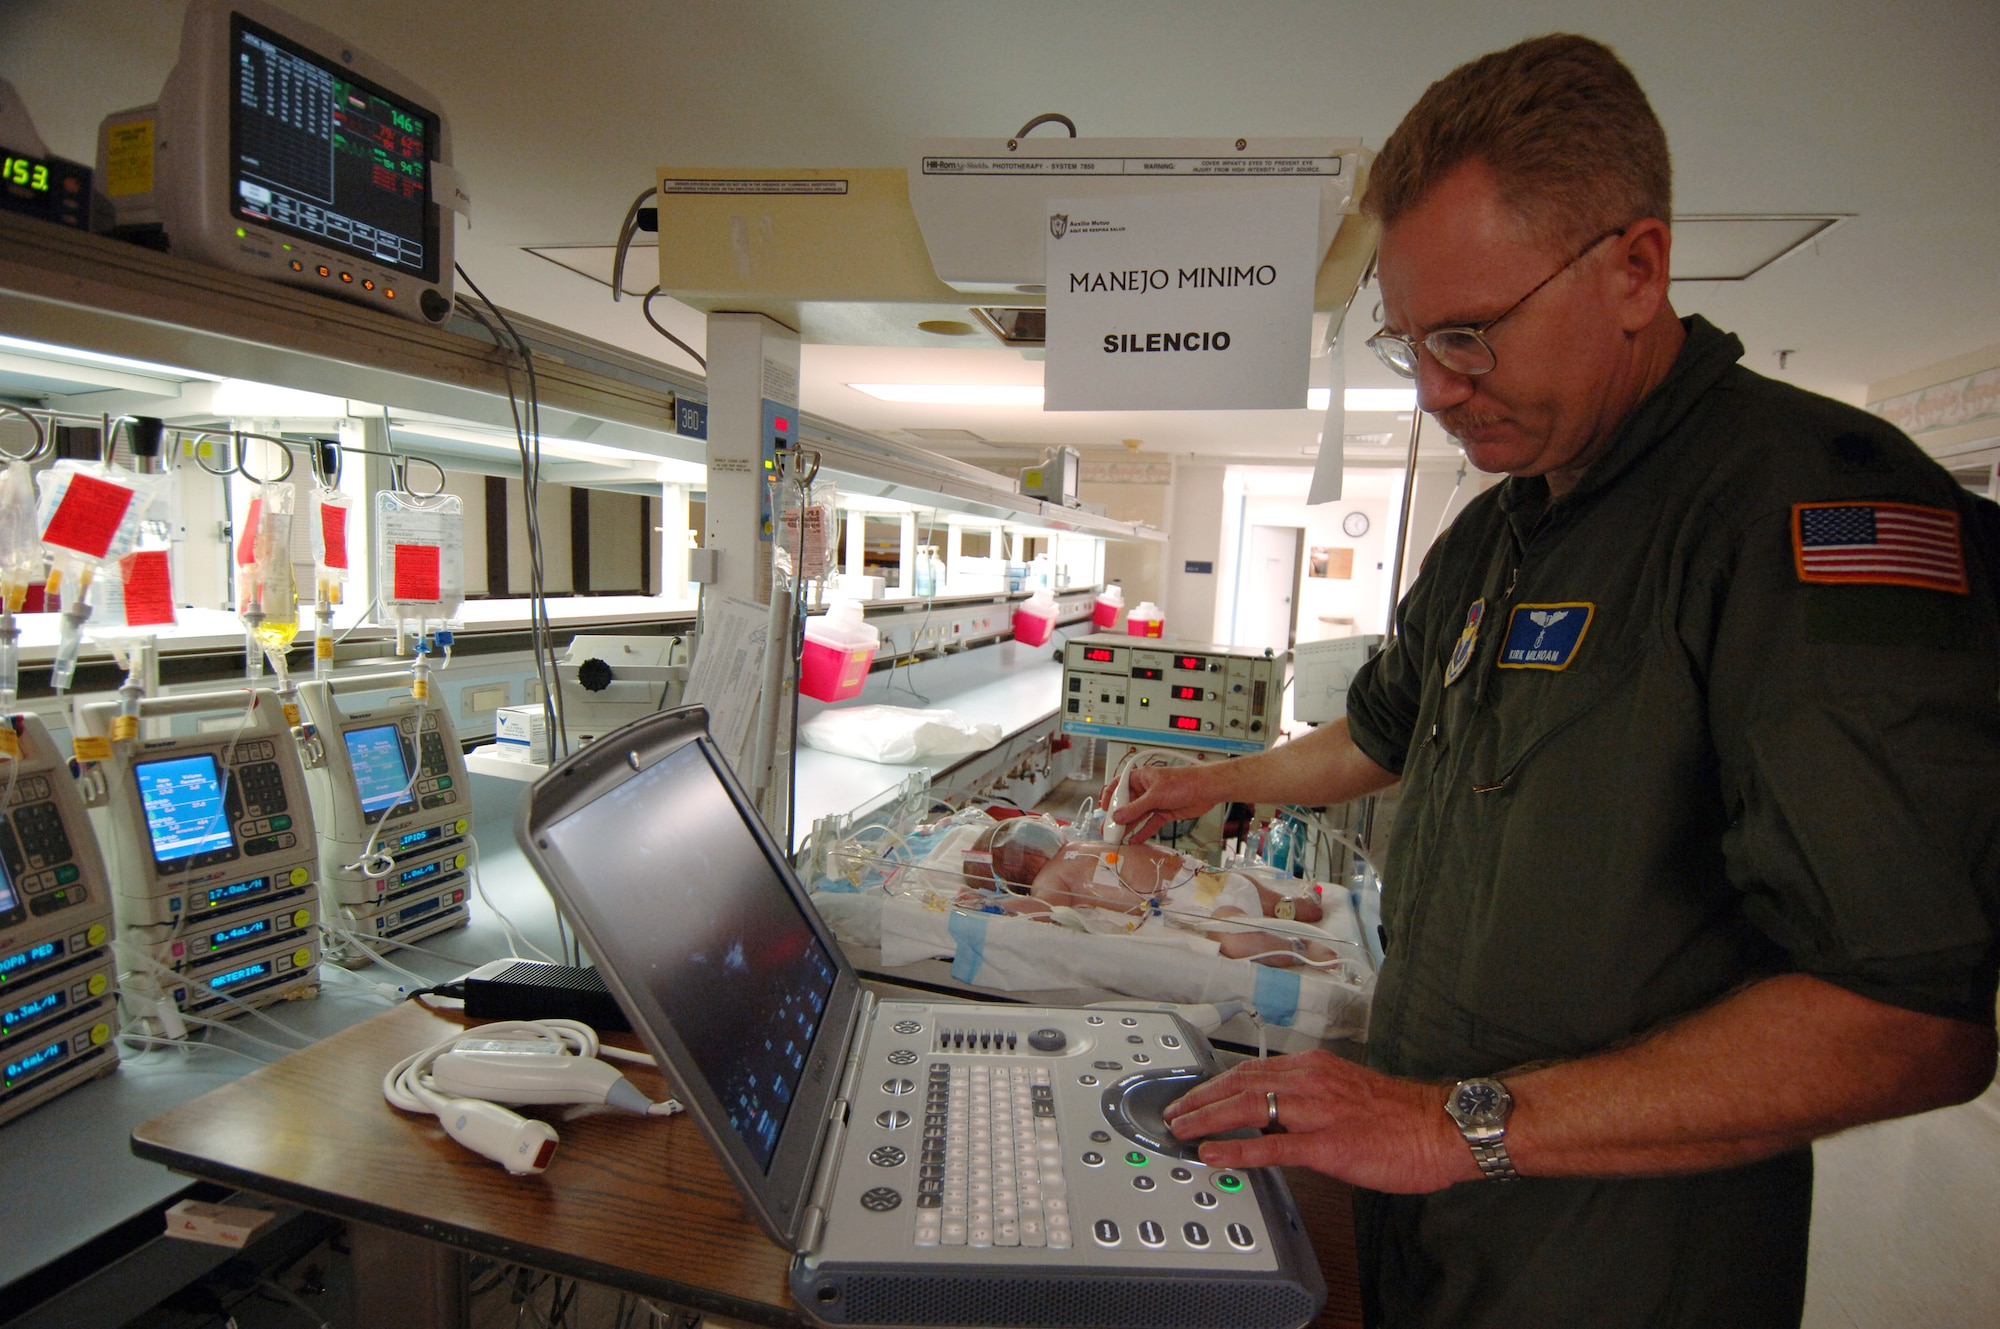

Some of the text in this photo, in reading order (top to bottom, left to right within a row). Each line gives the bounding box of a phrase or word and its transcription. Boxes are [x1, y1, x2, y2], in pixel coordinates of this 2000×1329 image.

[392, 110, 413, 132] 146
[1070, 264, 1277, 295] MANEJO MINIMO
[1102, 330, 1231, 354] SILENCIO
[1509, 650, 1559, 662] KIRK MILHOAN
[209, 879, 262, 900] 17.0mL/H
[215, 921, 264, 941] 0.4mL/H
[31, 943, 54, 960] PED
[210, 964, 264, 988] ARTERIAL
[5, 994, 57, 1024] 0.3mL/H
[7, 1044, 58, 1076] 0.6mL/H
